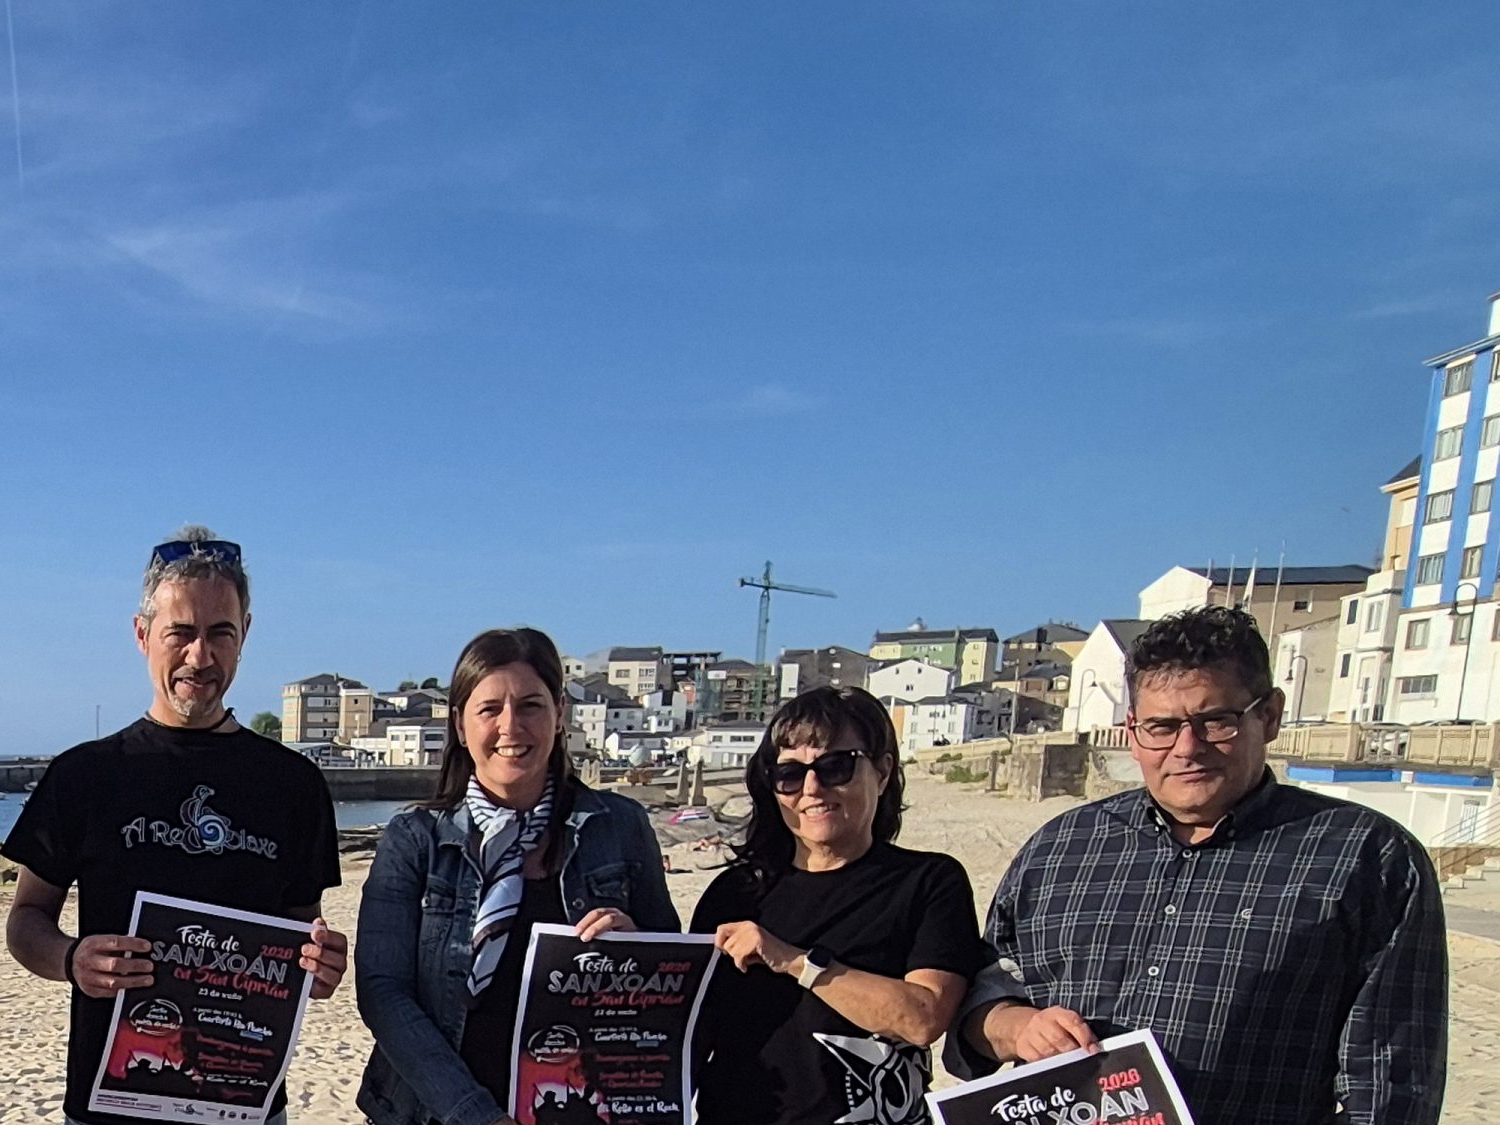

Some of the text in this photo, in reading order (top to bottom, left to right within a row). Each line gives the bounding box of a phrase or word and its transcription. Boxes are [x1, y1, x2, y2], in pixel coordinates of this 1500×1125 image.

[120, 817, 146, 848] A
[176, 925, 240, 952] Festa de
[150, 941, 204, 966] SAN
[573, 952, 638, 973] Festa de
[174, 967, 192, 980] en
[195, 964, 228, 986] San
[548, 970, 602, 993] SAN
[571, 996, 588, 1006] en
[592, 990, 624, 1006] San
[990, 1086, 1075, 1122] Festa de
